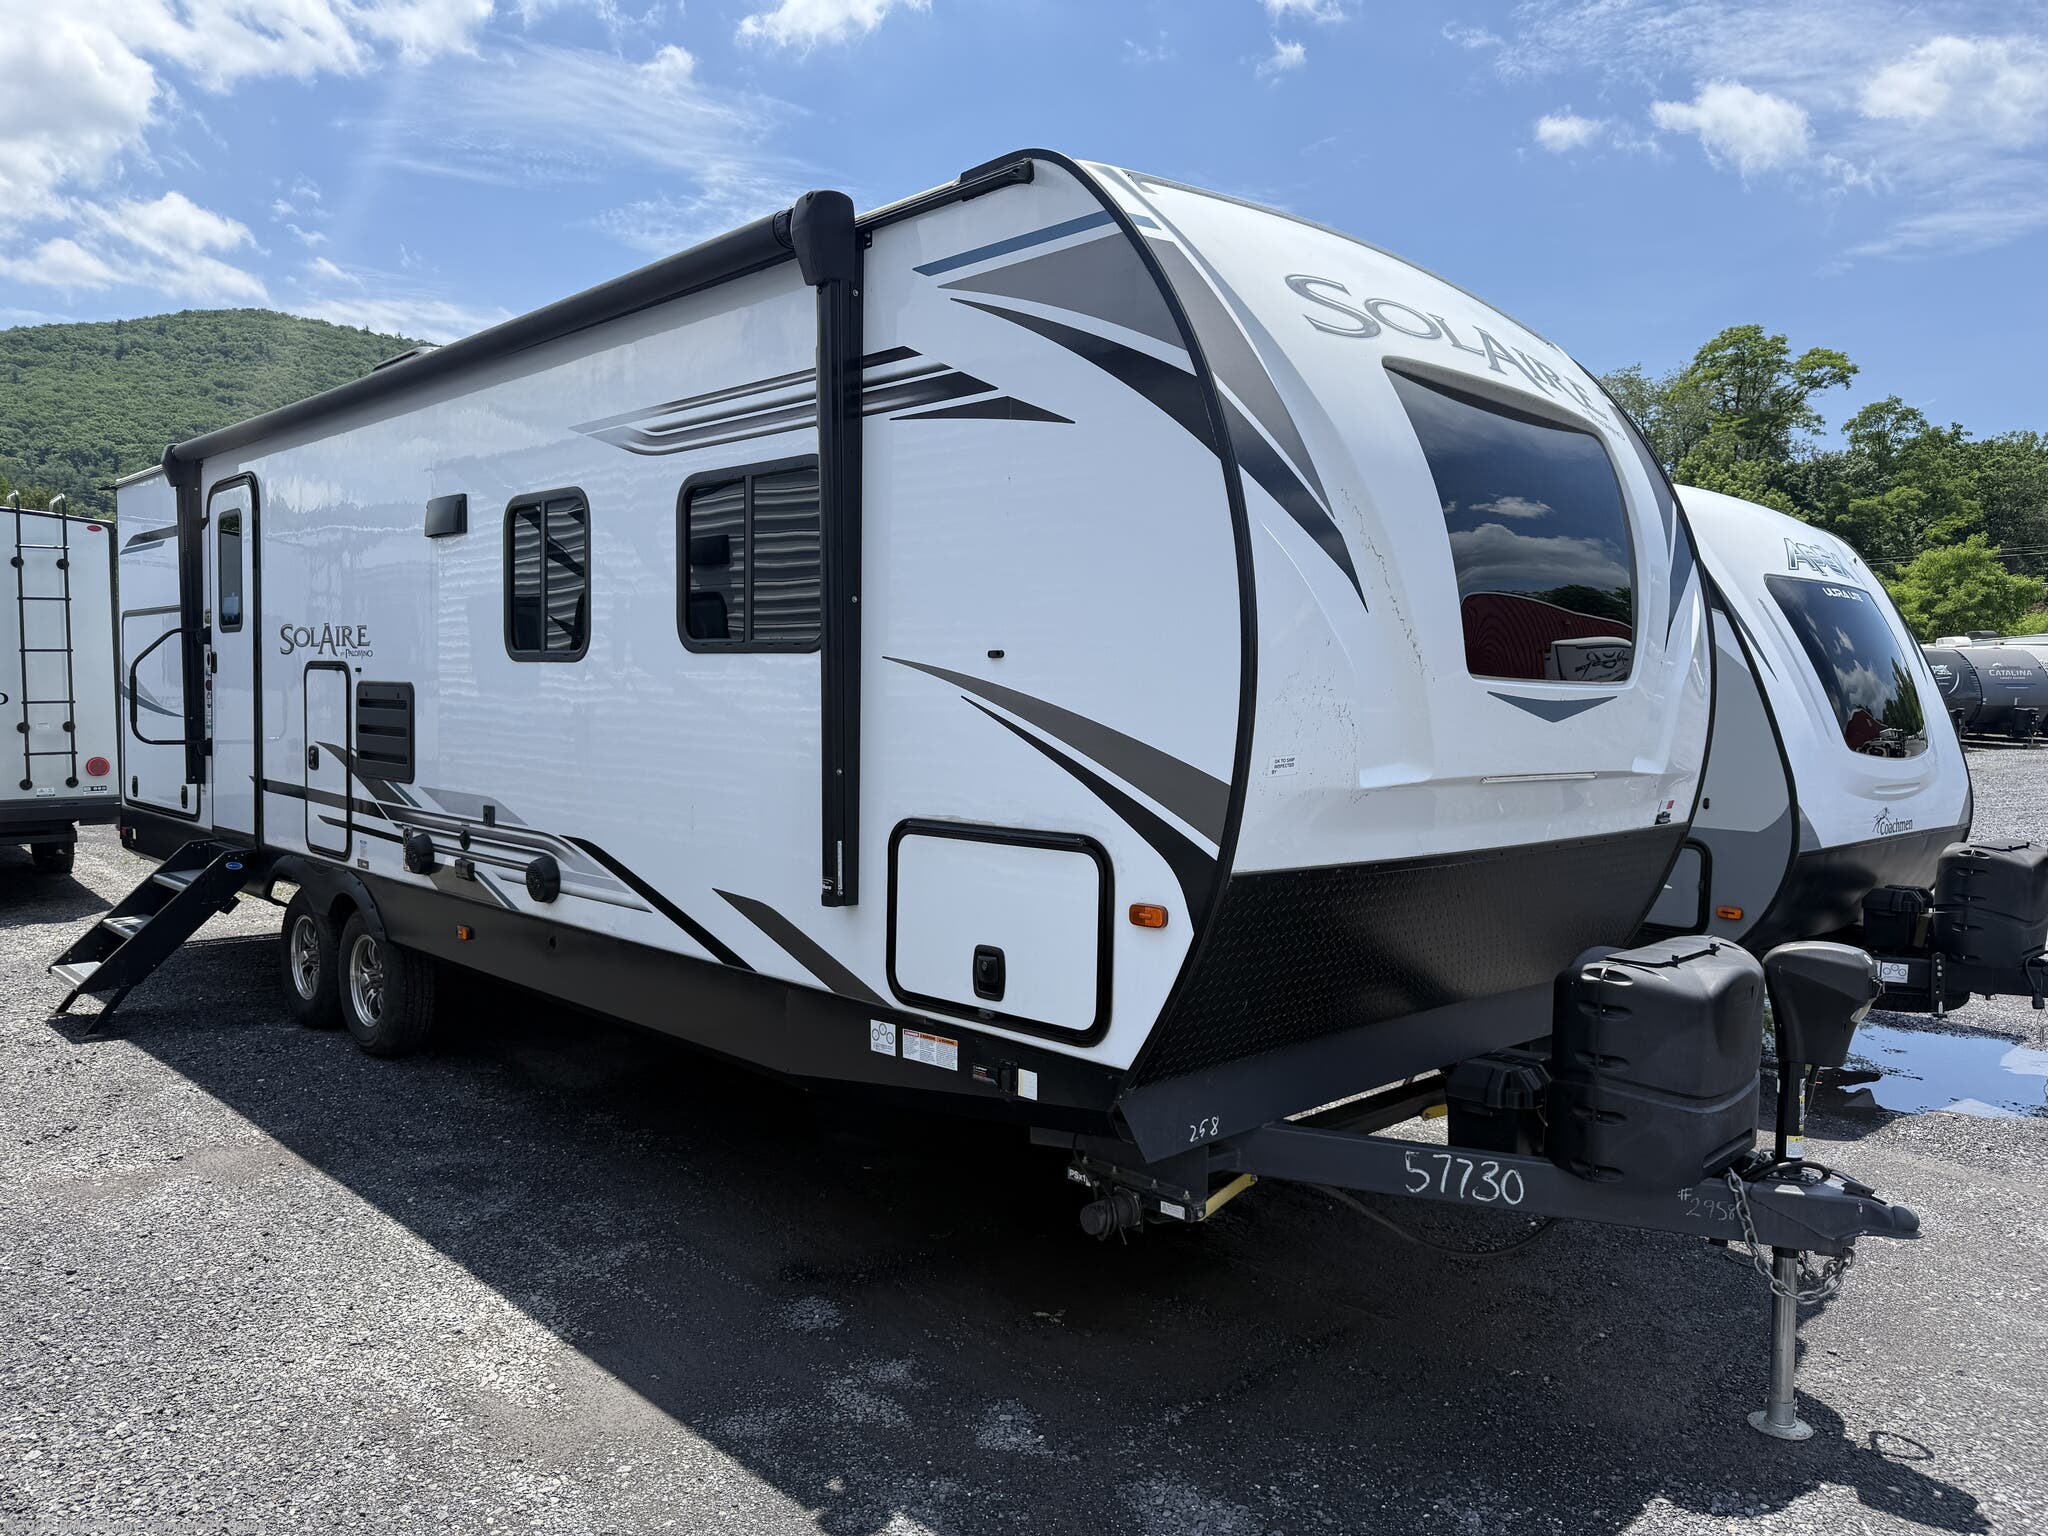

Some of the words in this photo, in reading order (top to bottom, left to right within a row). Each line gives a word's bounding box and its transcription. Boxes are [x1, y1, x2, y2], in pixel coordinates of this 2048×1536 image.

[1285, 274, 1608, 421] SOLAIRE
[280, 622, 371, 657] SOLAIRE
[1988, 669, 2033, 677] CATALINA
[1880, 817, 1913, 835] Coachmen
[1403, 1149, 1525, 1206] 57730
